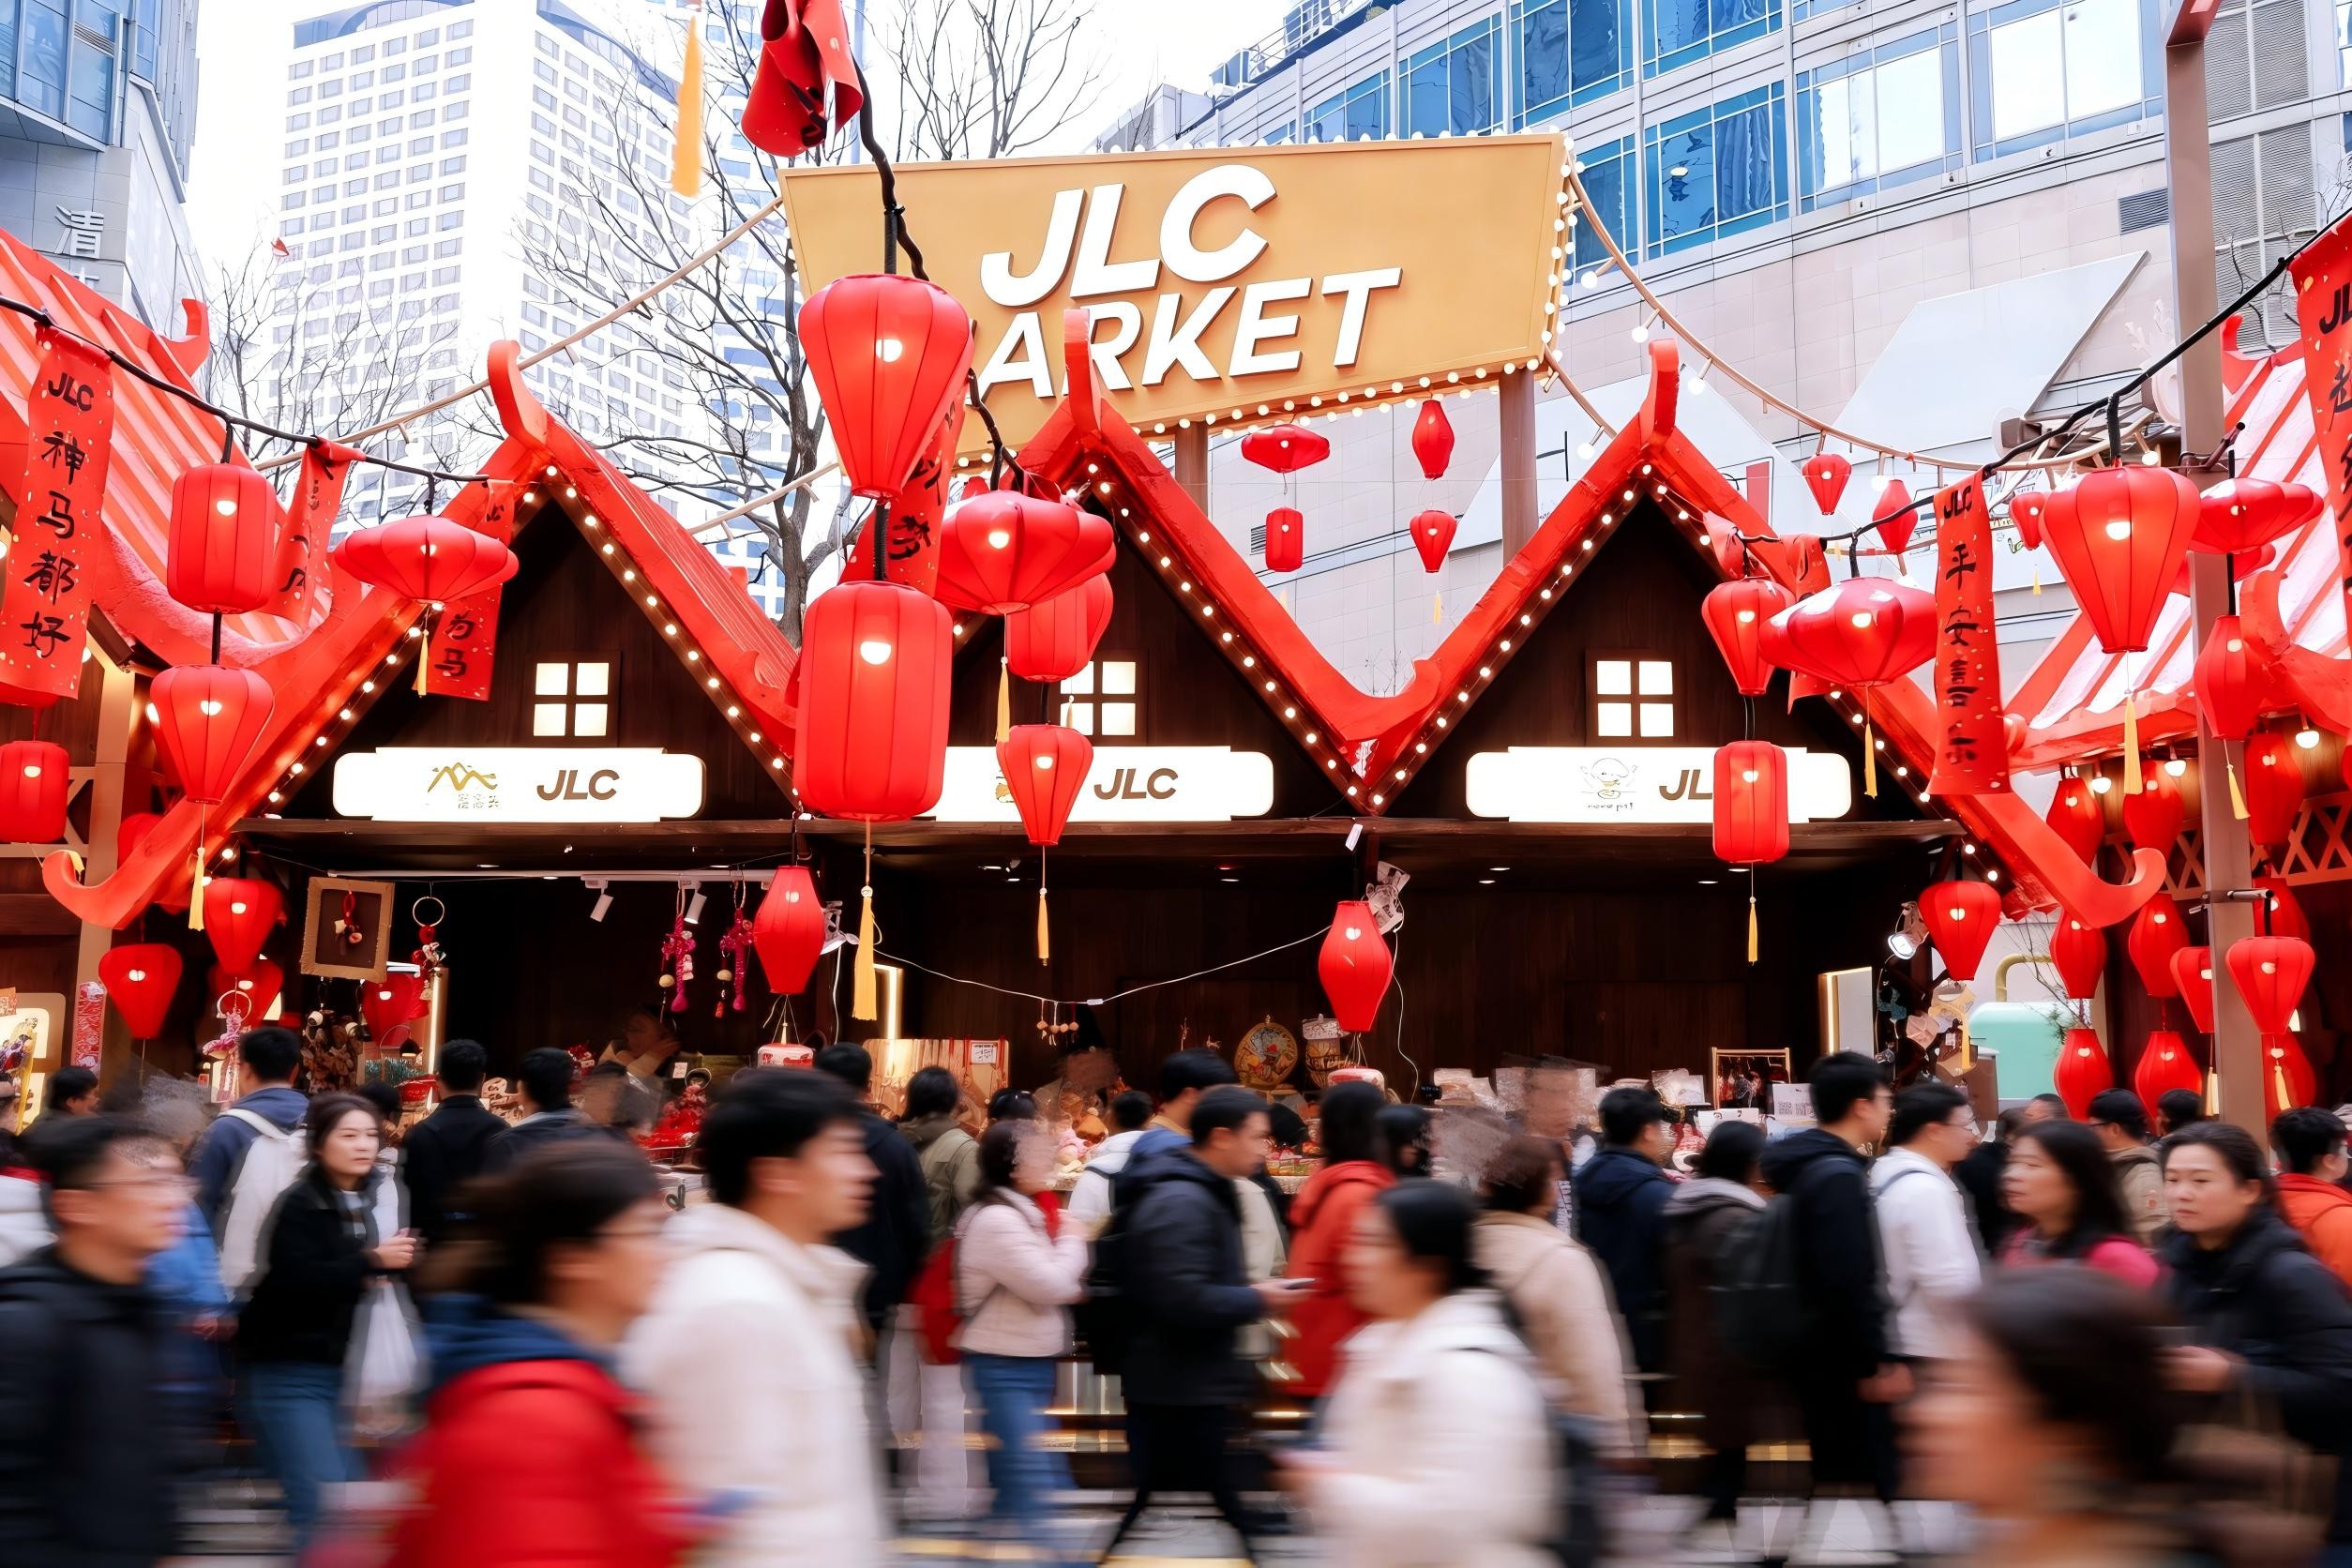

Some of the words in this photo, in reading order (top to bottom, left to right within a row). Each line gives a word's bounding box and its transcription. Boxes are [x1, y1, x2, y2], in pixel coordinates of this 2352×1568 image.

[980, 164, 1277, 307] JLC
[2319, 282, 2352, 335] JL
[964, 266, 1403, 406] ARKET
[48, 372, 93, 412] JLC
[1944, 486, 1972, 519] JLC
[20, 430, 86, 658] 神马都好
[536, 769, 621, 801] JLC
[1093, 767, 1179, 800] JLC
[1659, 769, 1713, 801] JL
